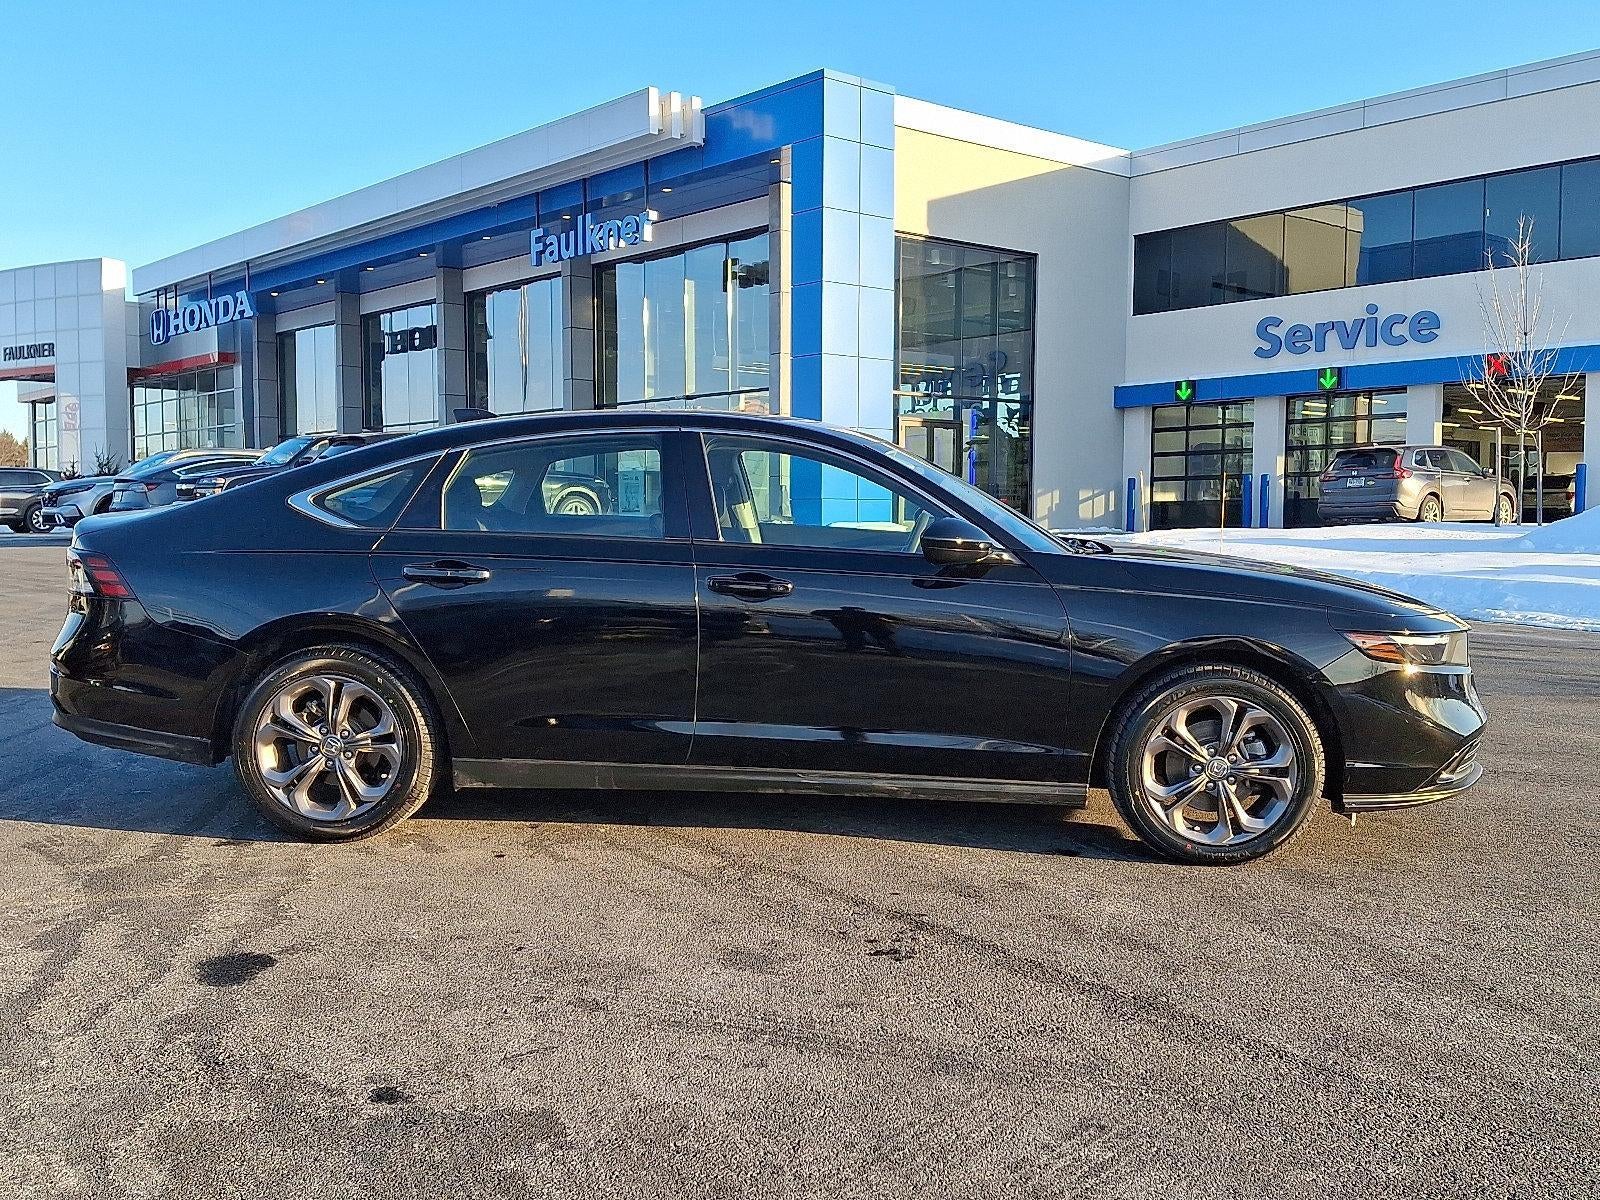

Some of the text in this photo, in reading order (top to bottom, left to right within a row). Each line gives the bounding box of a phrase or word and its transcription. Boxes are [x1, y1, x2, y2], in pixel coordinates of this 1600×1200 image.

[530, 209, 656, 267] Faulkner
[168, 290, 256, 336] HONDA
[1253, 303, 1441, 359] Service
[3, 342, 55, 361] FAULKNER
